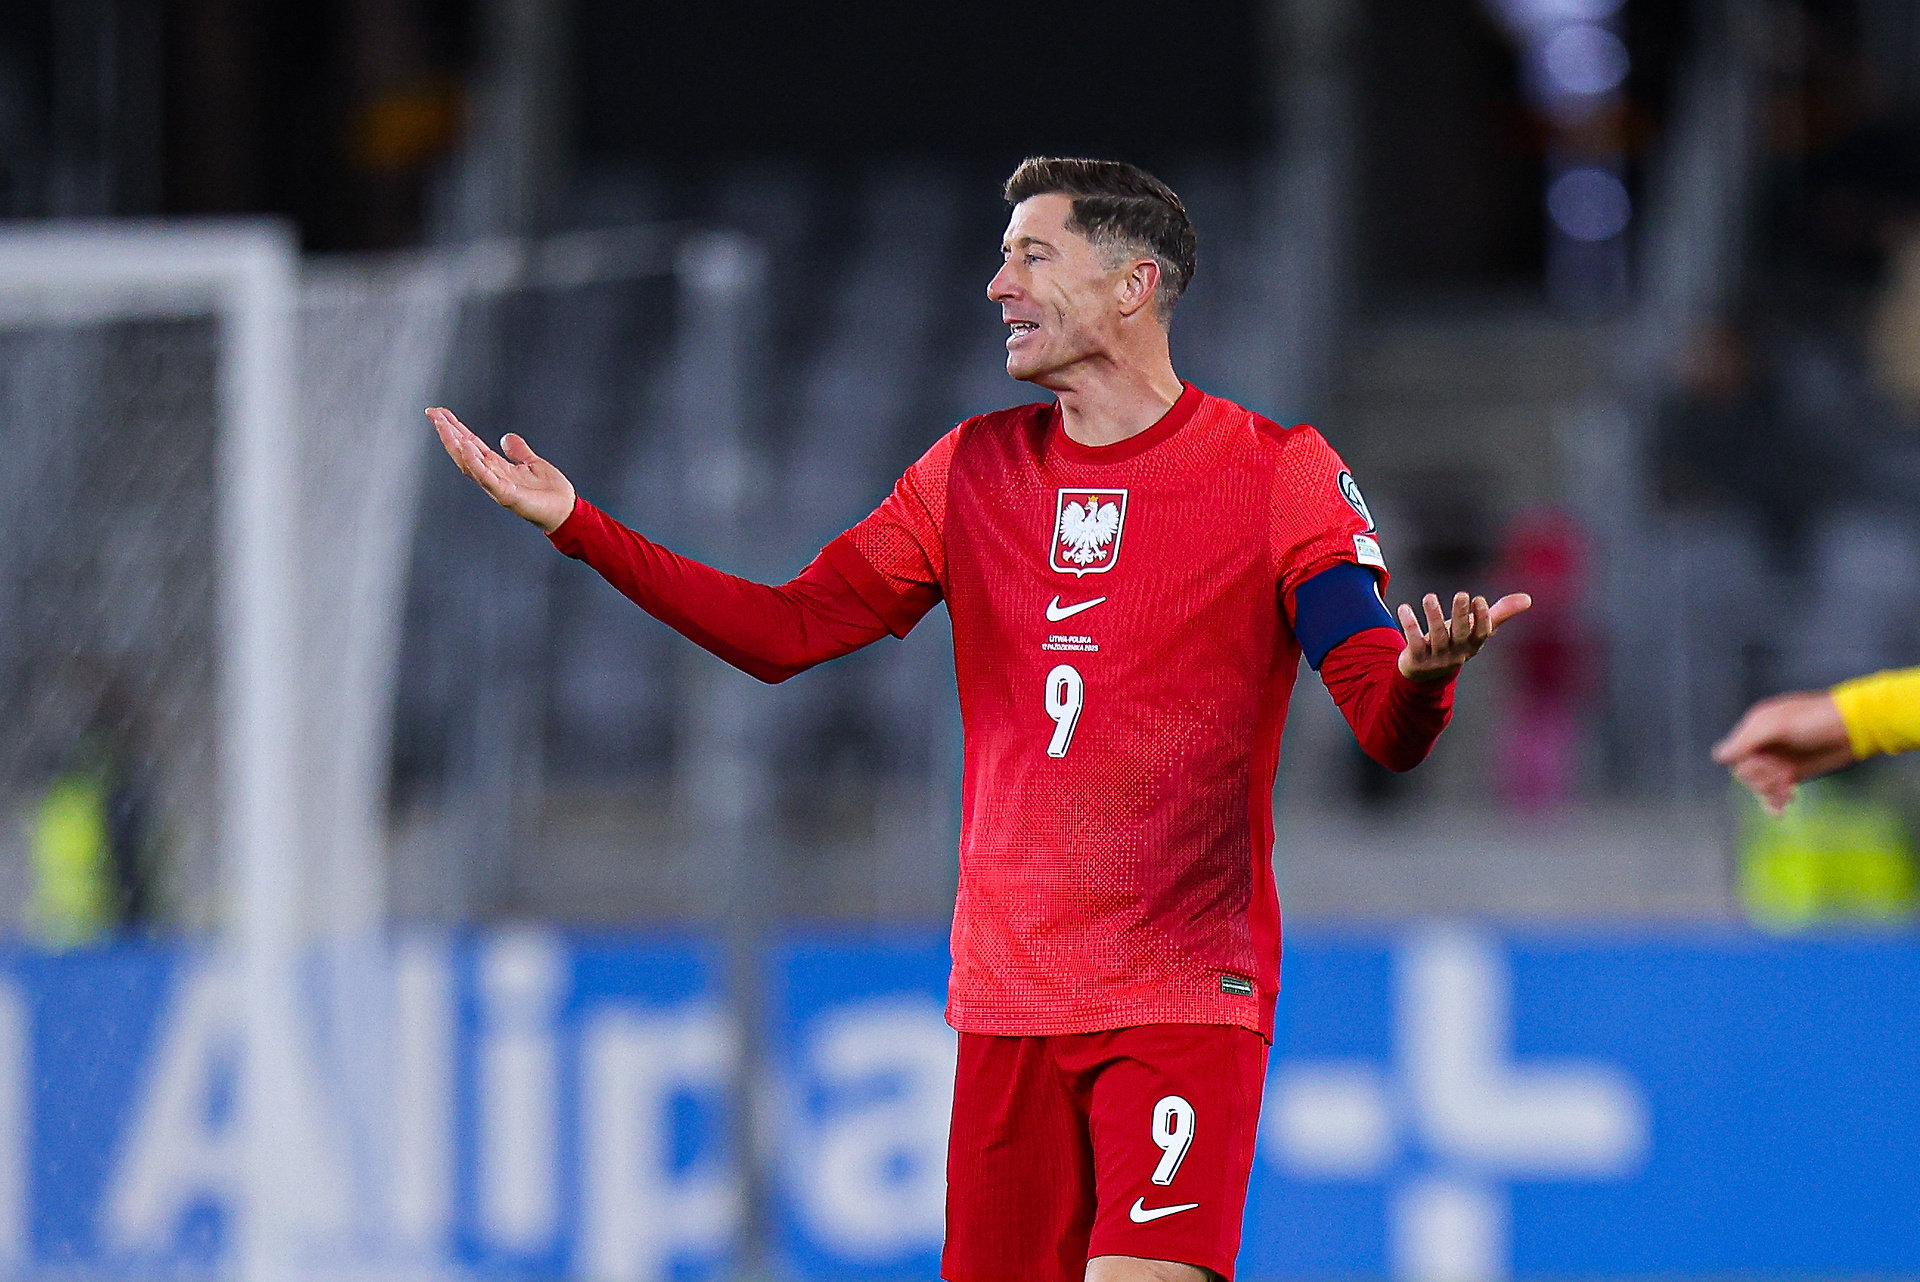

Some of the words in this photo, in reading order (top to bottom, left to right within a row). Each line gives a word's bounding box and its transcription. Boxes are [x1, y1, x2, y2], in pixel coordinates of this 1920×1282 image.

[1044, 664, 1084, 758] 9
[106, 930, 957, 1282] Alipa
[1151, 1095, 1196, 1186] 9
